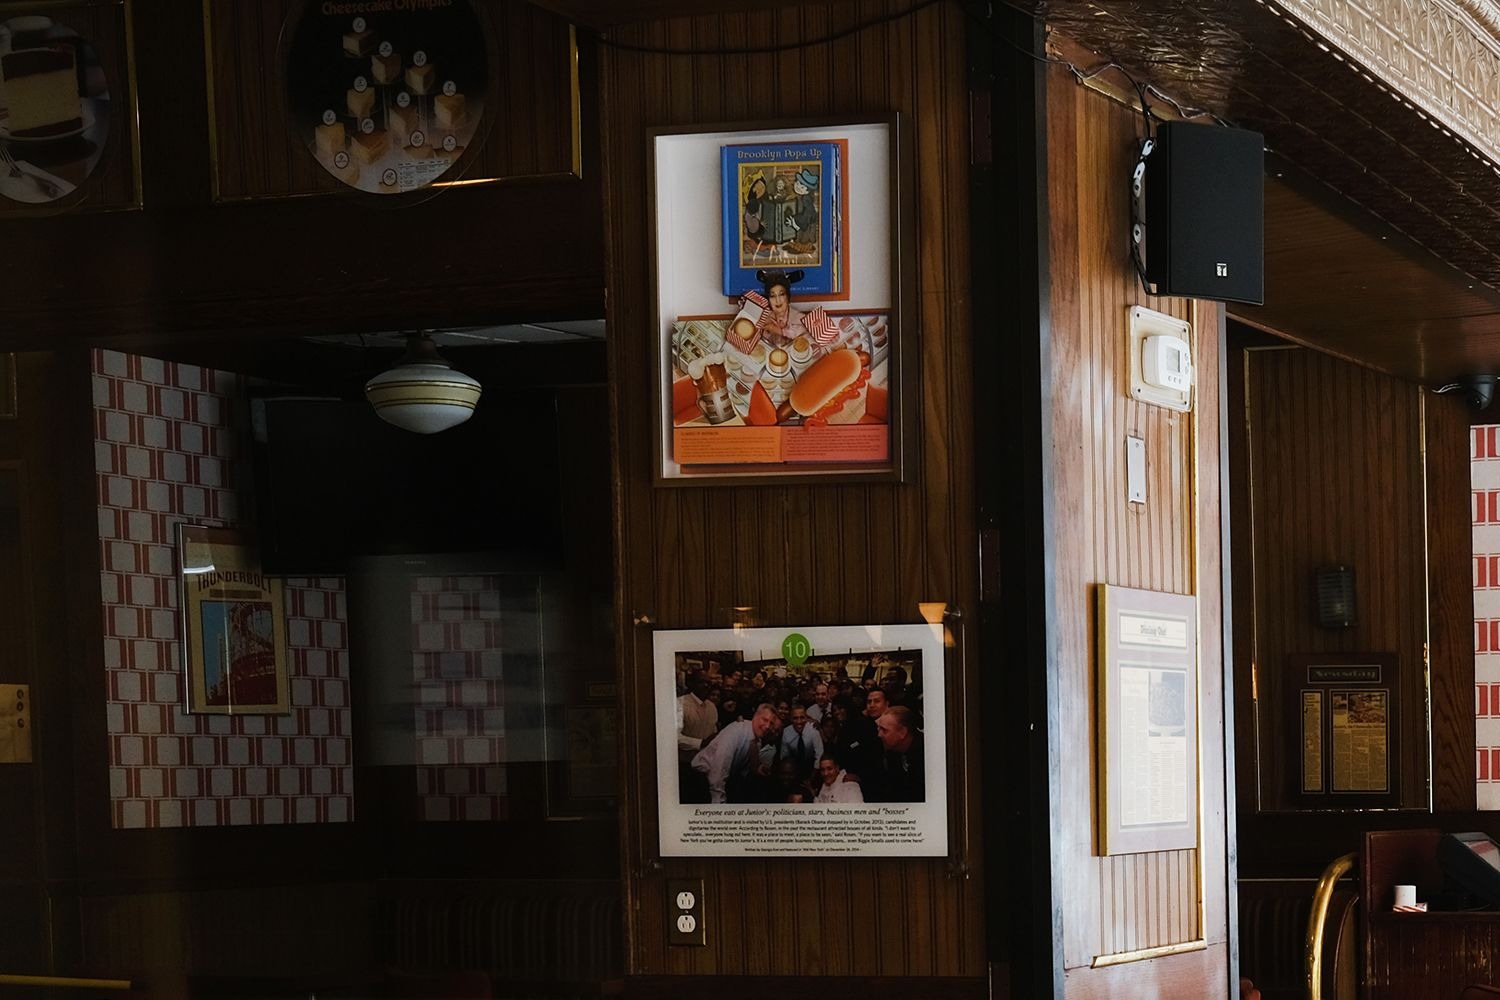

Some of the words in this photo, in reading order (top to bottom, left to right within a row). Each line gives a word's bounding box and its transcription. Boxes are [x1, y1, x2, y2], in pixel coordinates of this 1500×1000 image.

[321, 0, 393, 16] Cheesecake
[737, 149, 781, 161] Brooklyn
[784, 150, 807, 160] Pops
[810, 148, 822, 159] Up
[196, 571, 272, 595] THUNDERBOLT
[786, 641, 806, 658] 10
[694, 808, 722, 817] Everyone
